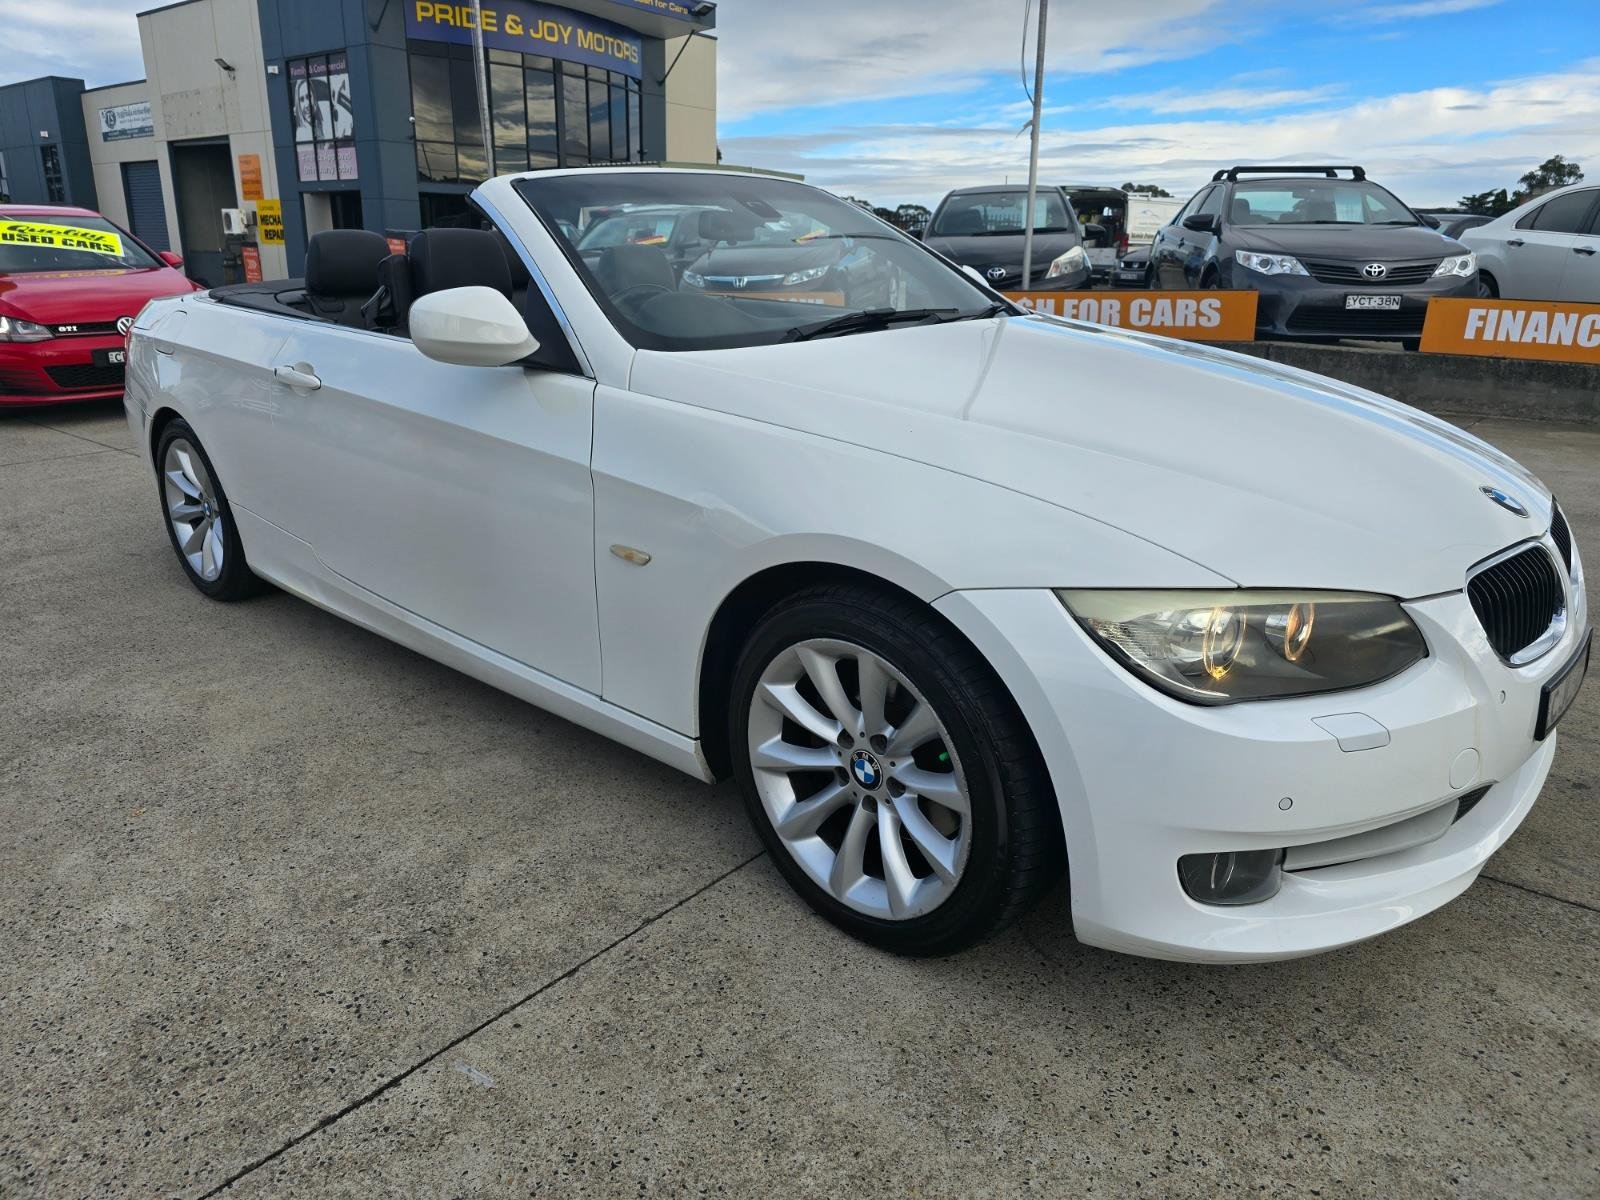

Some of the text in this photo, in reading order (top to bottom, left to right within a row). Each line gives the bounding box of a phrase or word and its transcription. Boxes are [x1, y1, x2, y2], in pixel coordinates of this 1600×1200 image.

[669, 2, 688, 14] Cars
[416, 1, 639, 64] PRIDE & JOY MOTORS
[2, 232, 115, 253] USED CARS
[7, 225, 106, 242] Quality
[1063, 298, 1121, 326] FOR
[1129, 298, 1221, 328] CARS
[1464, 308, 1600, 348] FINANC
[851, 752, 879, 770] BMW
